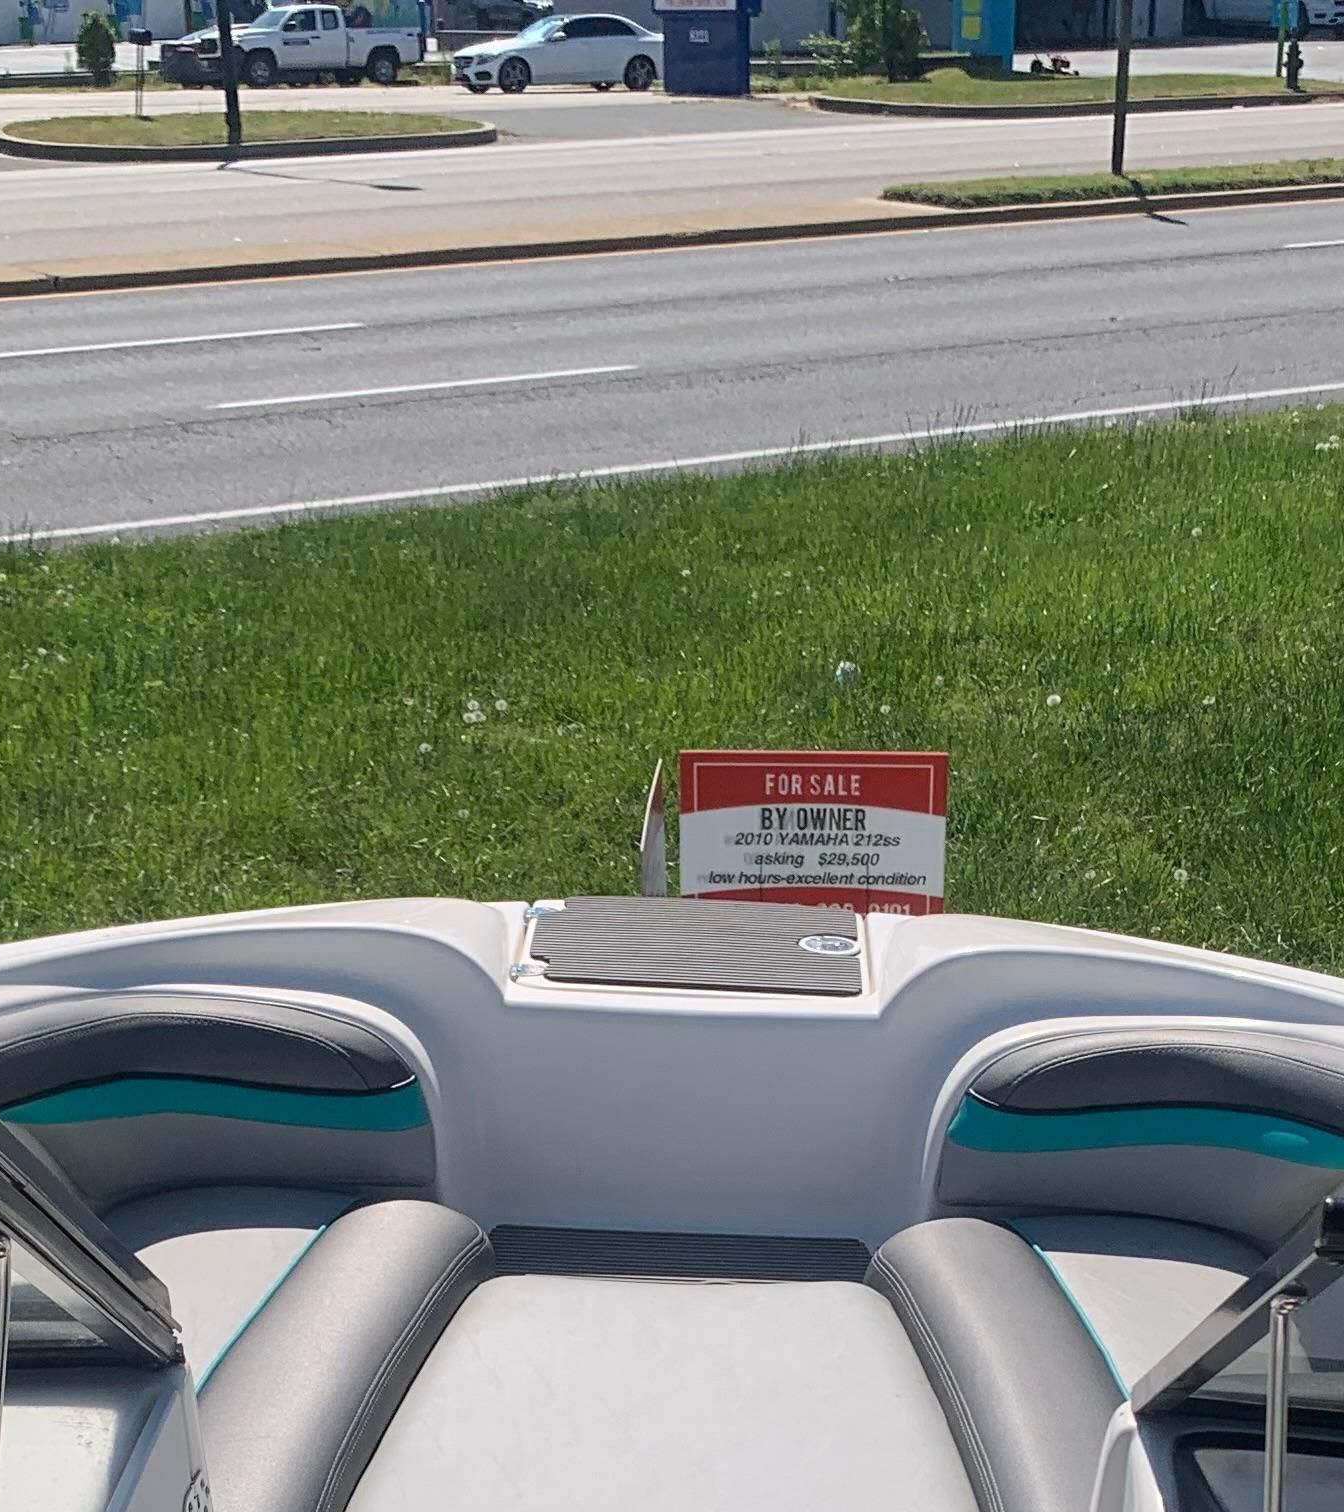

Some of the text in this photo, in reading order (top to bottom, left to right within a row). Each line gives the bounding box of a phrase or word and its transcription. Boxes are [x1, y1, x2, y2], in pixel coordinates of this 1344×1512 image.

[765, 773, 862, 797] FOR SALE
[761, 807, 867, 832] BY OWNER
[734, 832, 902, 847] 2010 YAMAHA 212ss
[754, 852, 881, 869] asking $29,500
[708, 872, 927, 887] low hours-excellent condition
